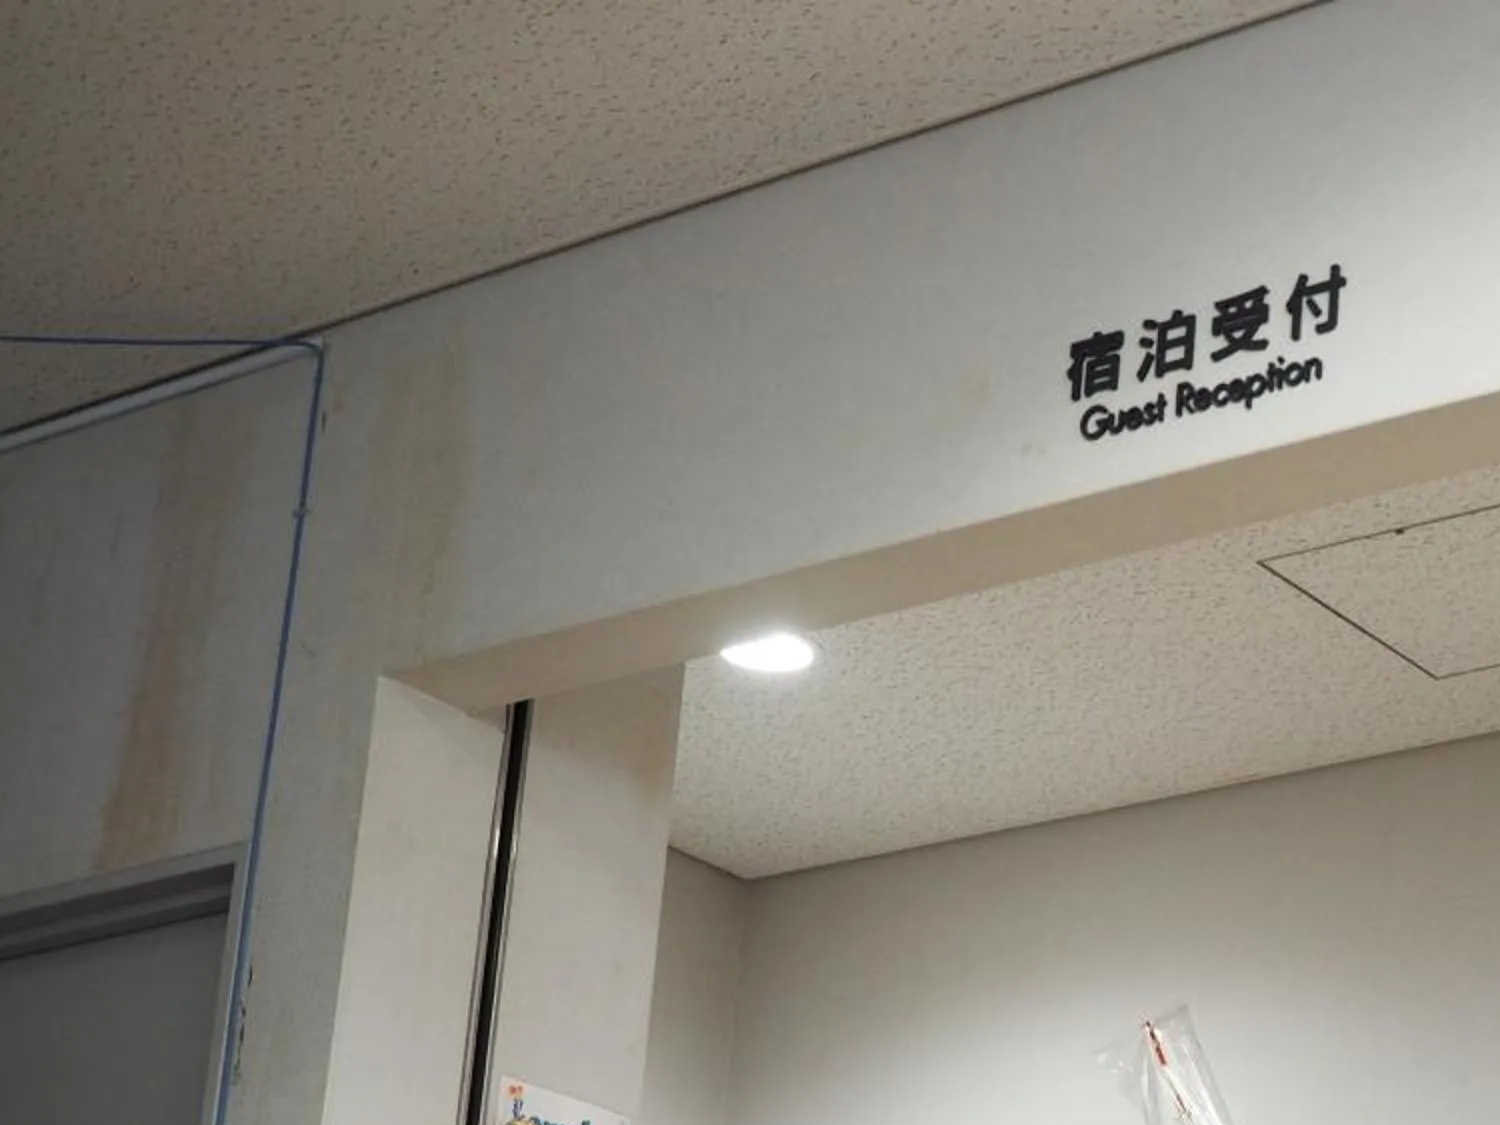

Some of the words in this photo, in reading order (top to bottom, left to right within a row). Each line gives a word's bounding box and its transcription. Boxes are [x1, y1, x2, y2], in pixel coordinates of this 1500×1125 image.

[1067, 264, 1347, 401] 宿泊受付
[1080, 393, 1167, 441] Guest
[1175, 356, 1323, 417] Reception
